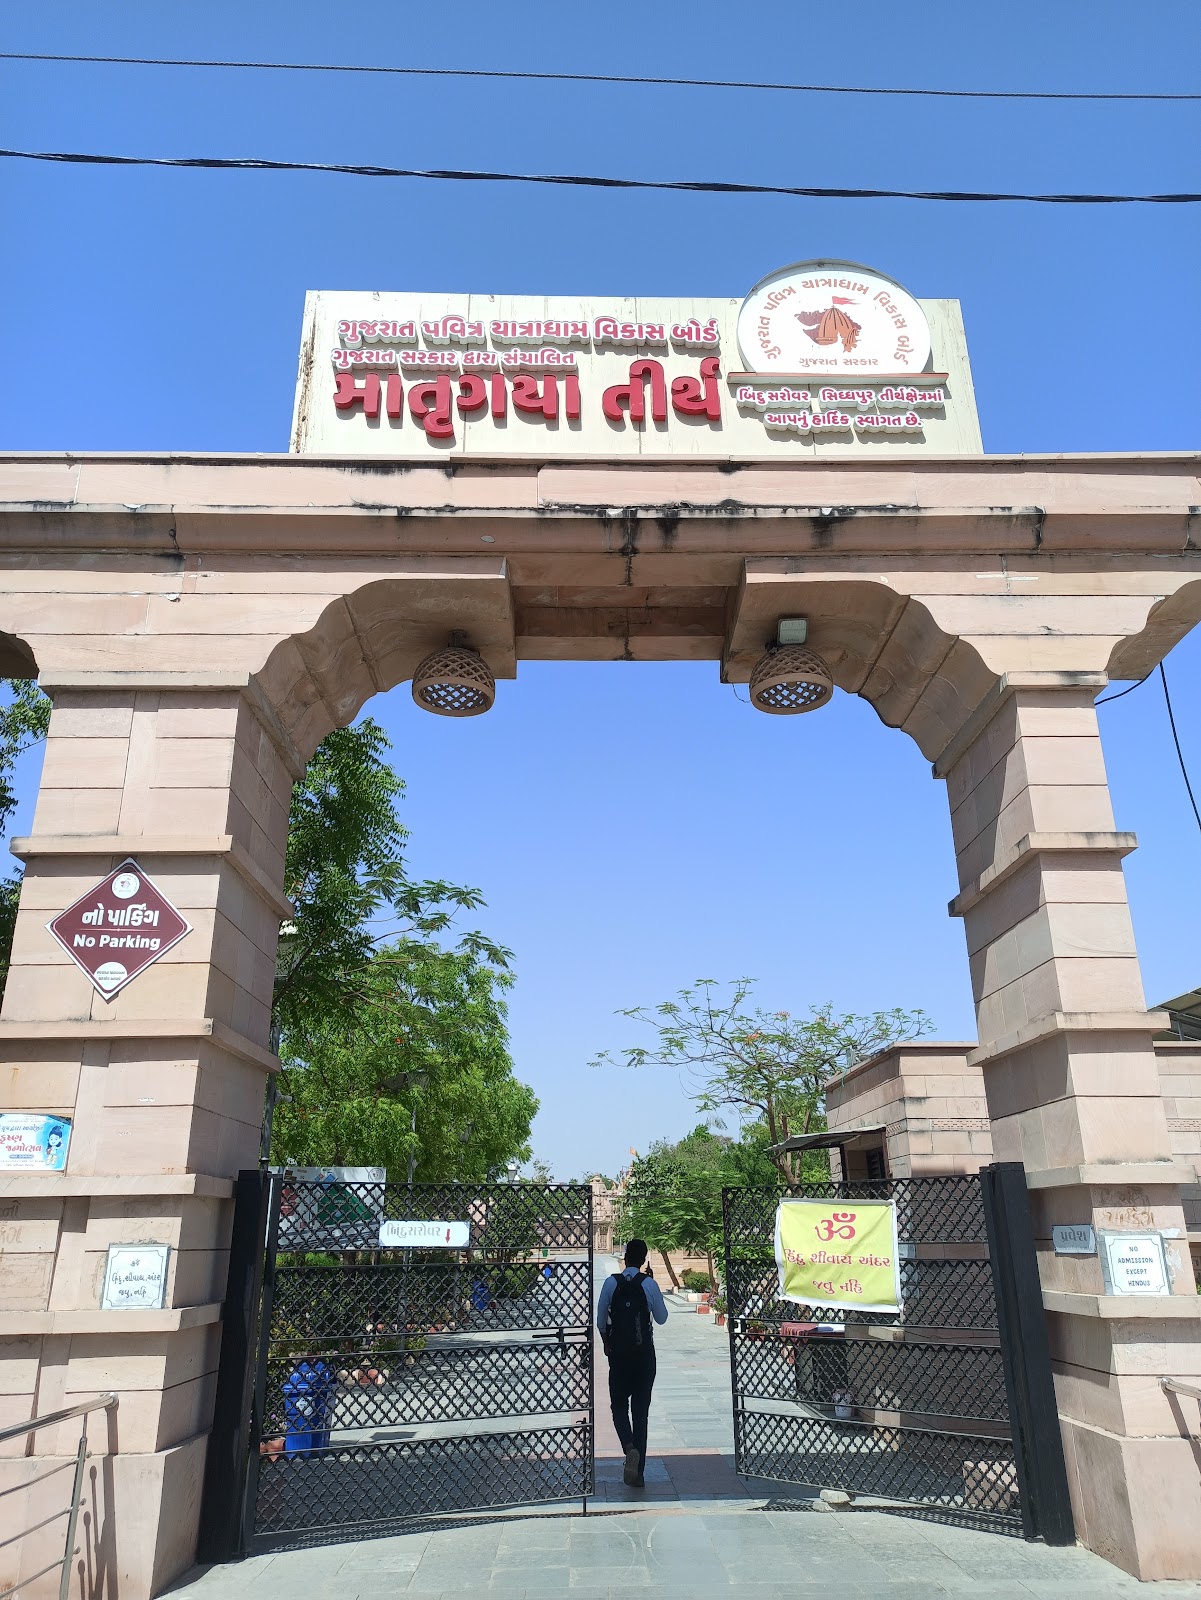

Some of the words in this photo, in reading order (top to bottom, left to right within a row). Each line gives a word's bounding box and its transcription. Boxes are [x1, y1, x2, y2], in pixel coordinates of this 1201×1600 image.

[801, 278, 870, 295] યાત્રાધામ
[764, 285, 797, 312] પવિત્ર
[873, 290, 907, 329] વિકાસ
[341, 320, 415, 342] ગુજરાત
[422, 316, 484, 338] પવિત્ર
[491, 320, 588, 338] યાત્રાધામ
[594, 317, 665, 339] વિકાસ
[671, 319, 719, 342] બોર્ડ
[757, 315, 782, 360] ગુજરાત
[333, 349, 393, 368] ગુજરાત
[400, 351, 455, 364] સરકાર
[463, 352, 496, 365] દ્વારા
[503, 348, 575, 365] સંચાલિત
[894, 335, 915, 365] બોર્ડ
[798, 357, 838, 368] ગુજરાત
[842, 358, 879, 367] સરકાર
[334, 371, 580, 439] માતૃગયા
[601, 356, 721, 422] તીર્થ
[739, 387, 765, 403] બિંદુ
[768, 388, 809, 401] સરોવર
[766, 411, 808, 428] આપનું
[811, 411, 849, 426] હાર્દિક
[857, 415, 901, 426] સ્વાગત
[82, 903, 104, 926] નો
[107, 903, 160, 927] પાર્કિંગ
[73, 934, 96, 948] No
[99, 934, 161, 951] Parking
[1060, 1227, 1088, 1242] પ્રવેશ
[810, 1251, 852, 1265] શીવાય
[859, 1254, 891, 1267] અંદર
[812, 1280, 835, 1294] જવુ
[839, 1279, 863, 1294] નહિ
